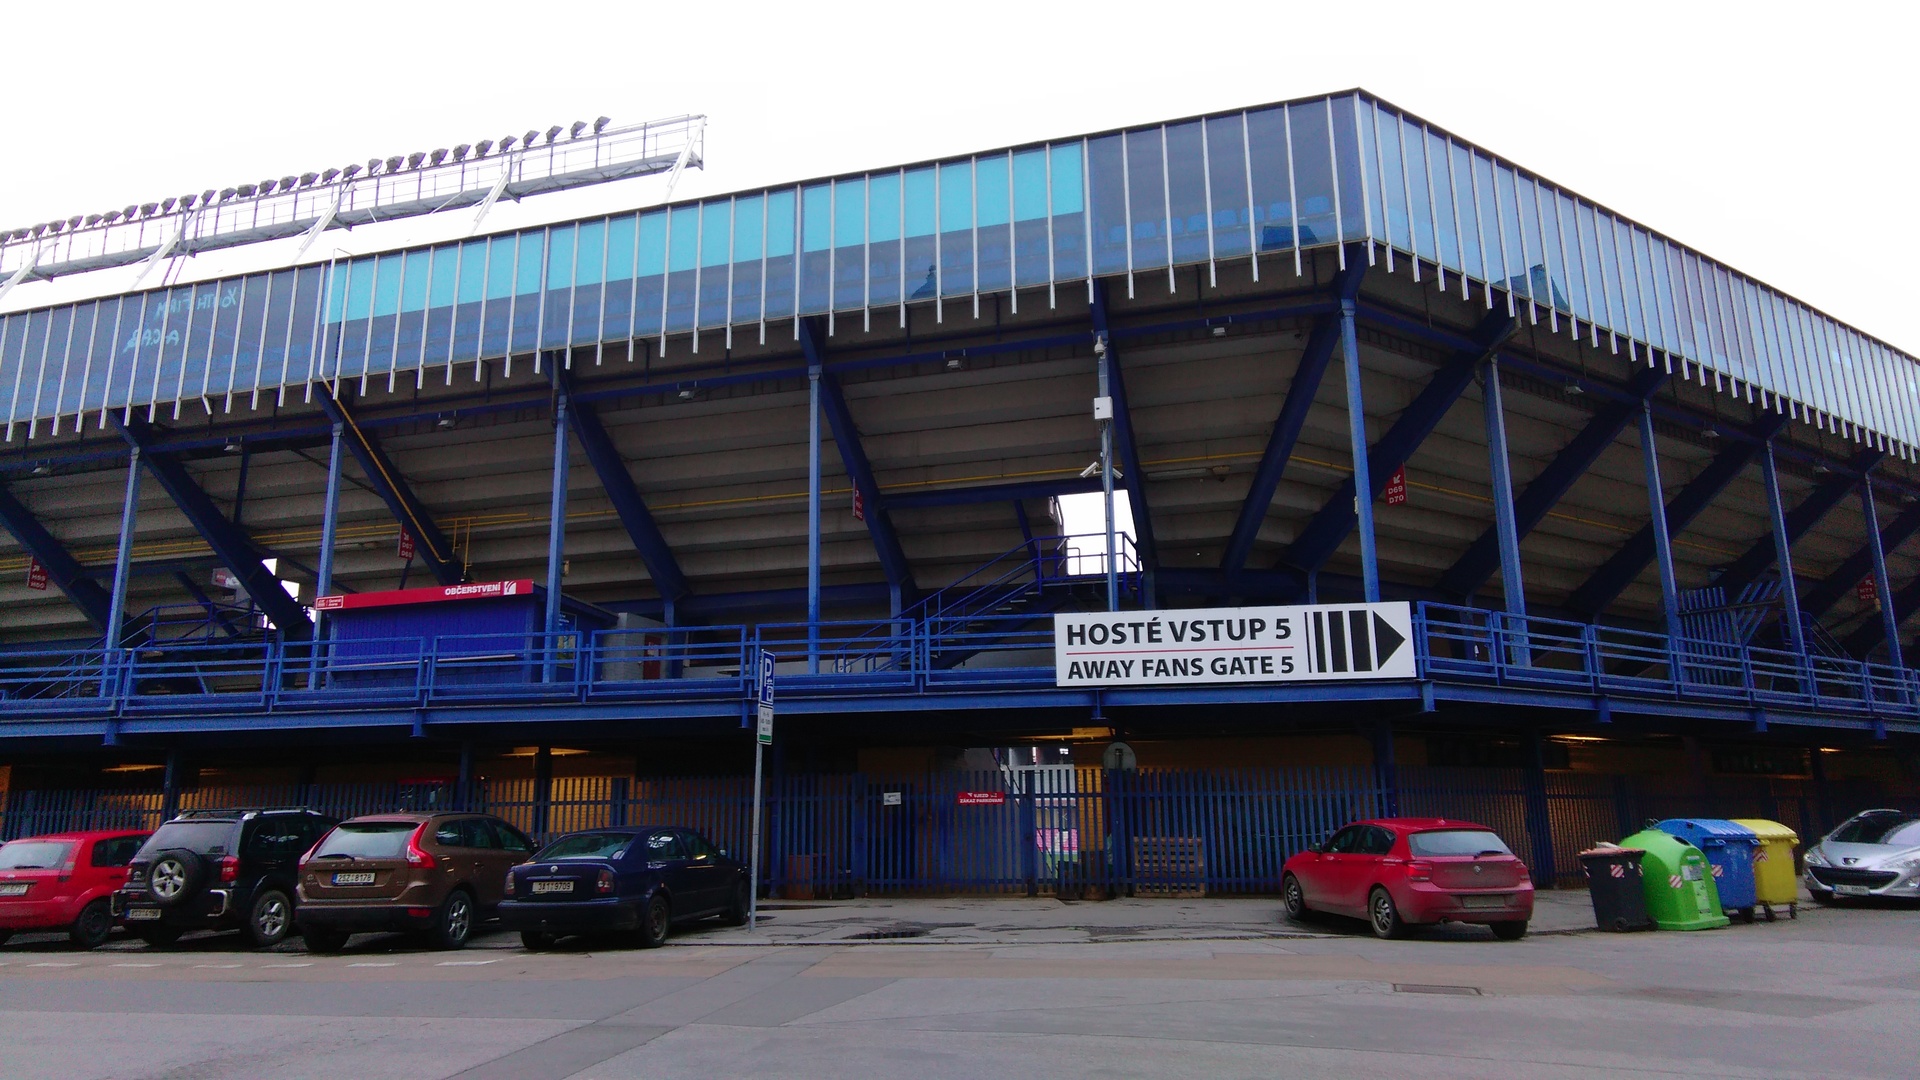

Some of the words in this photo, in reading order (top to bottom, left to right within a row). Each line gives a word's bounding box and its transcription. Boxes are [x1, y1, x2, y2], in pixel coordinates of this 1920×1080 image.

[1388, 485, 1403, 494] D69
[1389, 495, 1404, 504] D70
[445, 581, 501, 595] OBČERSTVENÍ
[1067, 617, 1163, 645] HOSTÉ
[1168, 618, 1266, 643] VSTUP
[1275, 618, 1292, 640] 5
[764, 658, 773, 687] P
[1068, 659, 1135, 680] AWAY
[1142, 657, 1204, 677] FANS
[1210, 655, 1275, 676] GATE
[1281, 656, 1295, 674] 5
